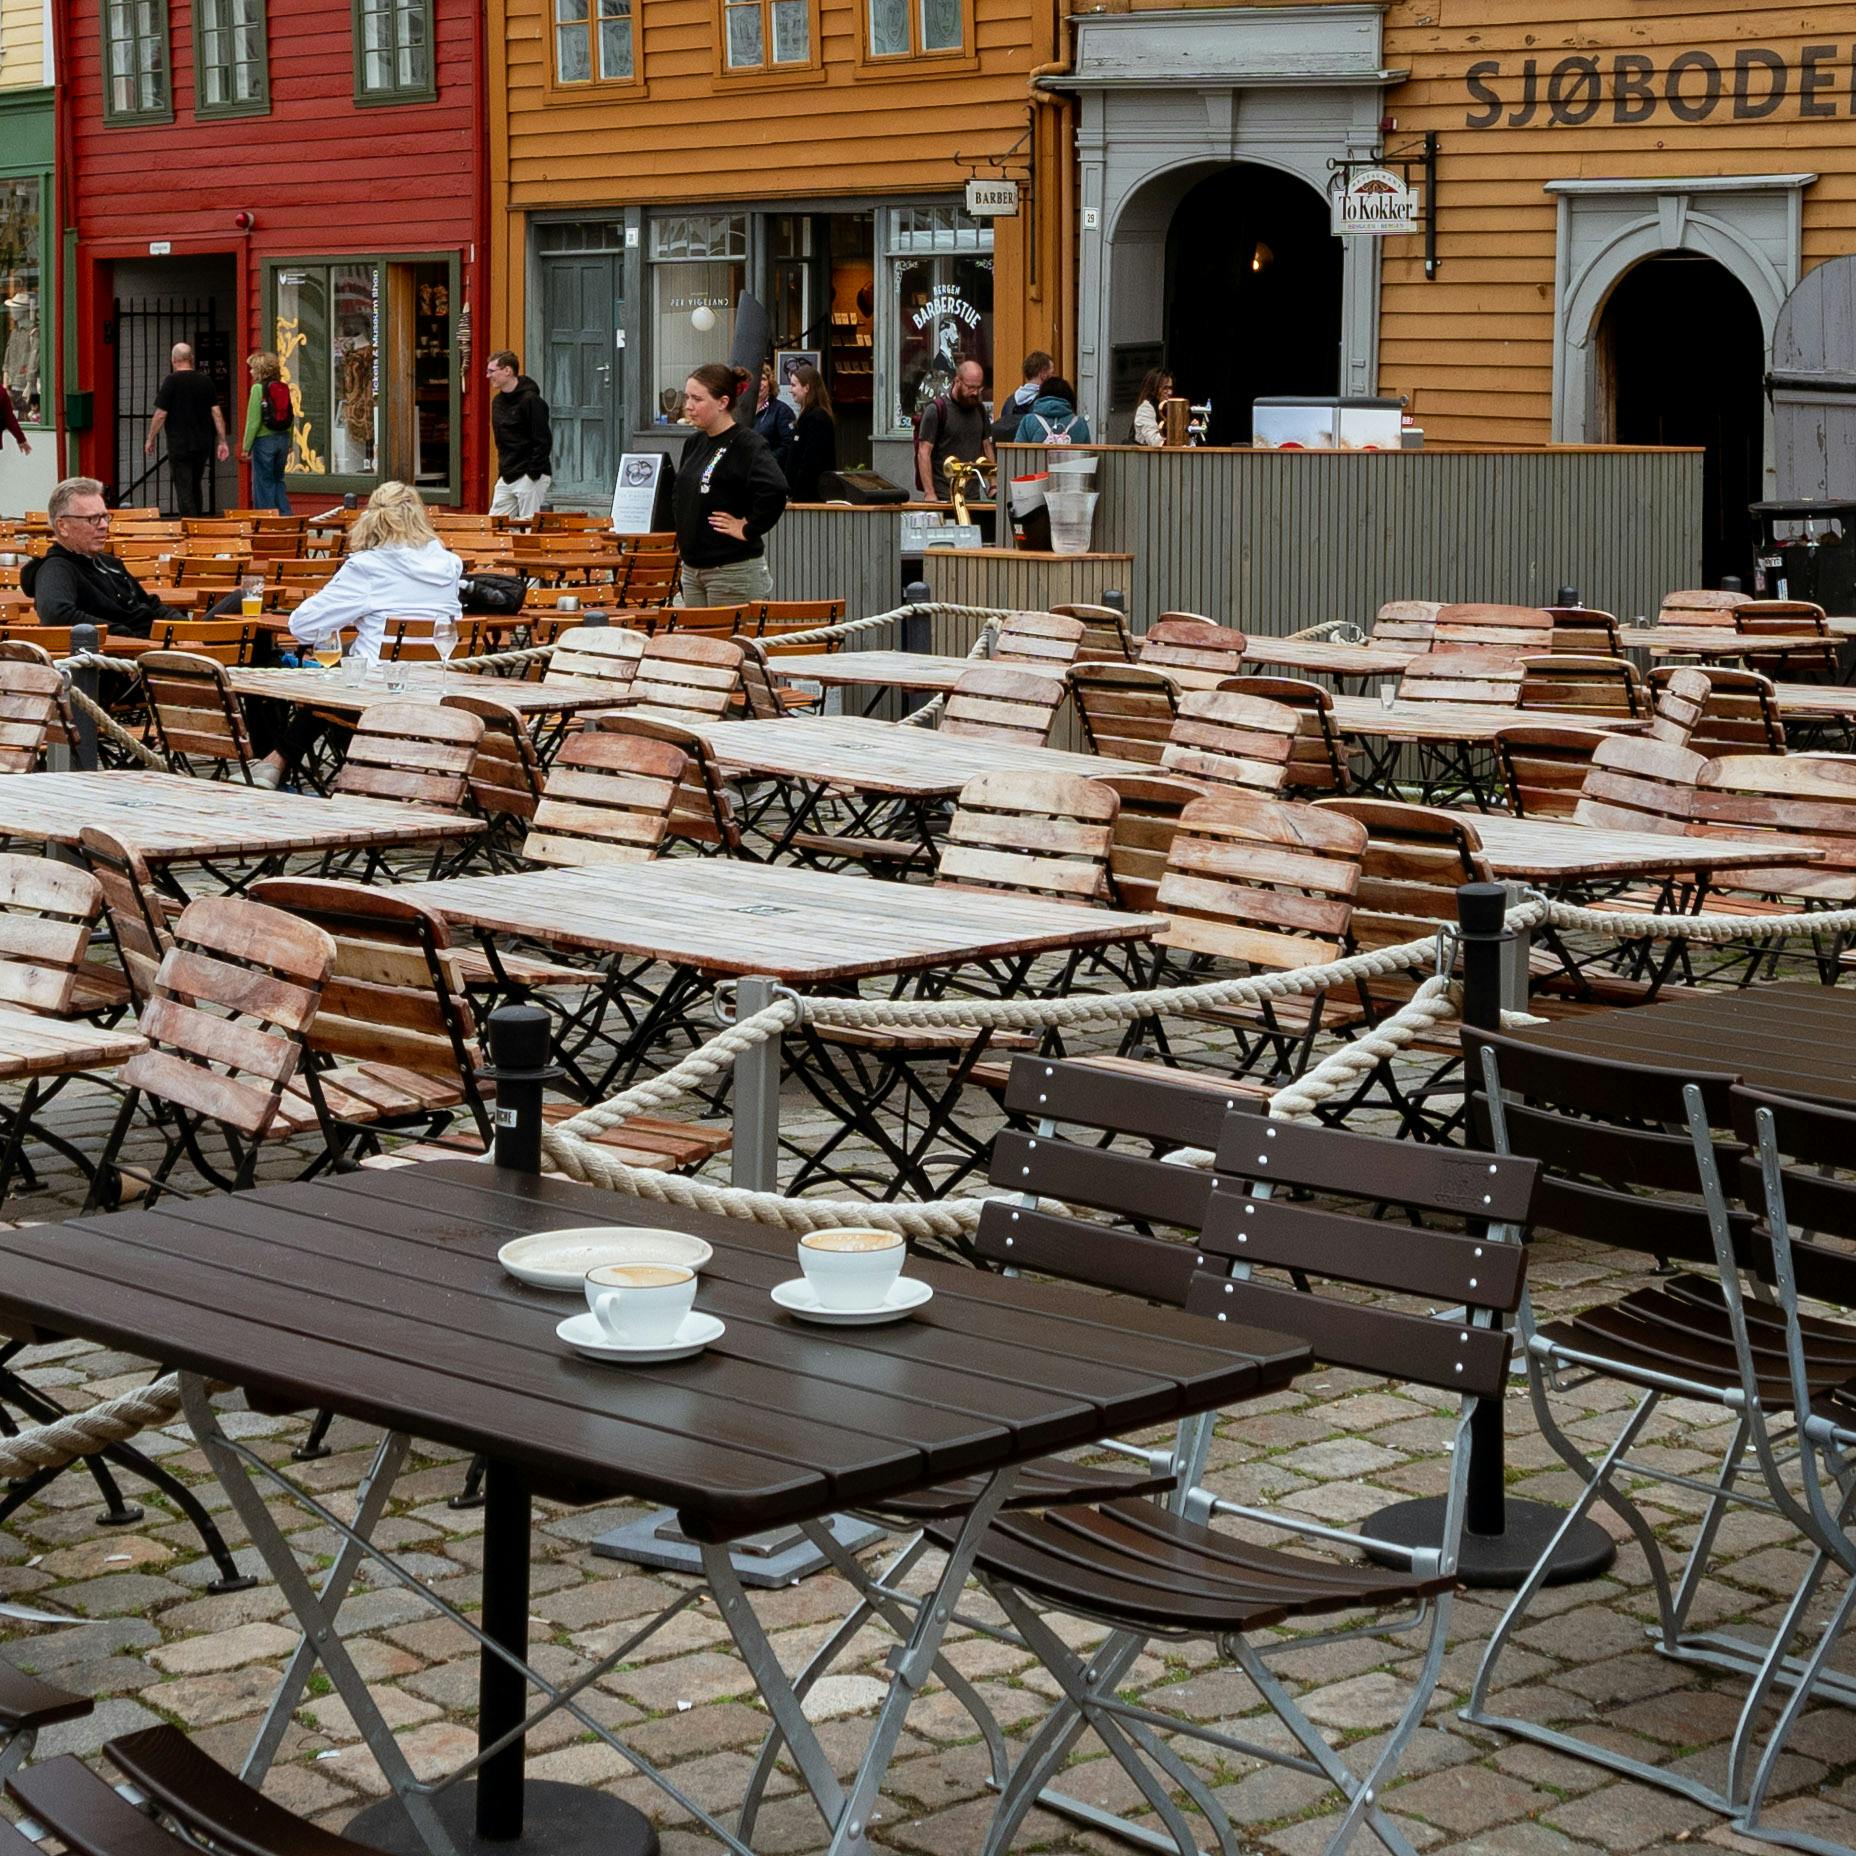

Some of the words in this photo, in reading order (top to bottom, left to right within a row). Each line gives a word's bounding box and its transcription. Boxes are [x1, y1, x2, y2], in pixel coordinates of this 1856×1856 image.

[975, 191, 1014, 205] BARBER
[1338, 196, 1357, 220] To
[1359, 195, 1413, 220] Kokker
[933, 284, 961, 295] BERGEN
[912, 296, 982, 330] BARBERSTUE
